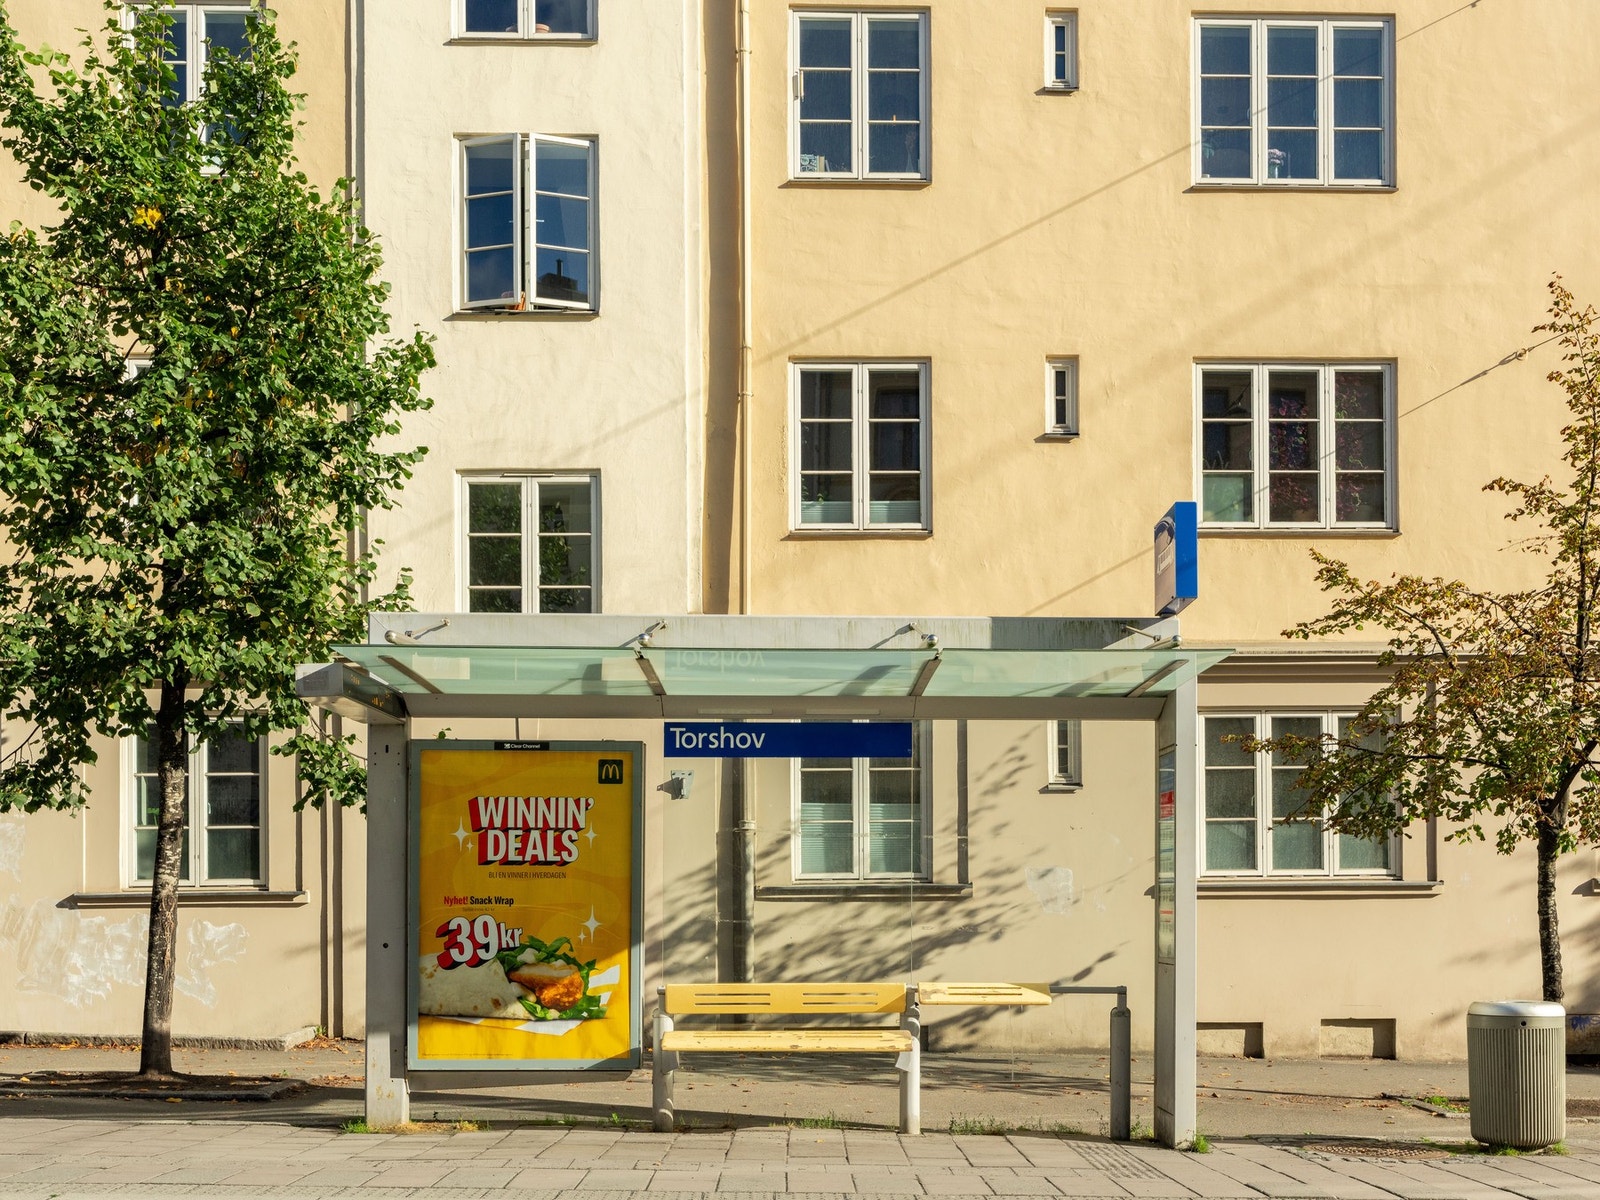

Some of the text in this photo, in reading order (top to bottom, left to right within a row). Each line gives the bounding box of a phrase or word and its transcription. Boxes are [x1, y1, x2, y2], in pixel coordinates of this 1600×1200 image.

[670, 726, 765, 749] Torshov
[479, 829, 579, 866] DEALS
[488, 871, 498, 879] BLI
[498, 871, 506, 879] EN
[507, 871, 528, 879] VINNER
[532, 871, 566, 879] HVERDAGEN
[444, 896, 514, 907] Nyhet! Snack Wrap
